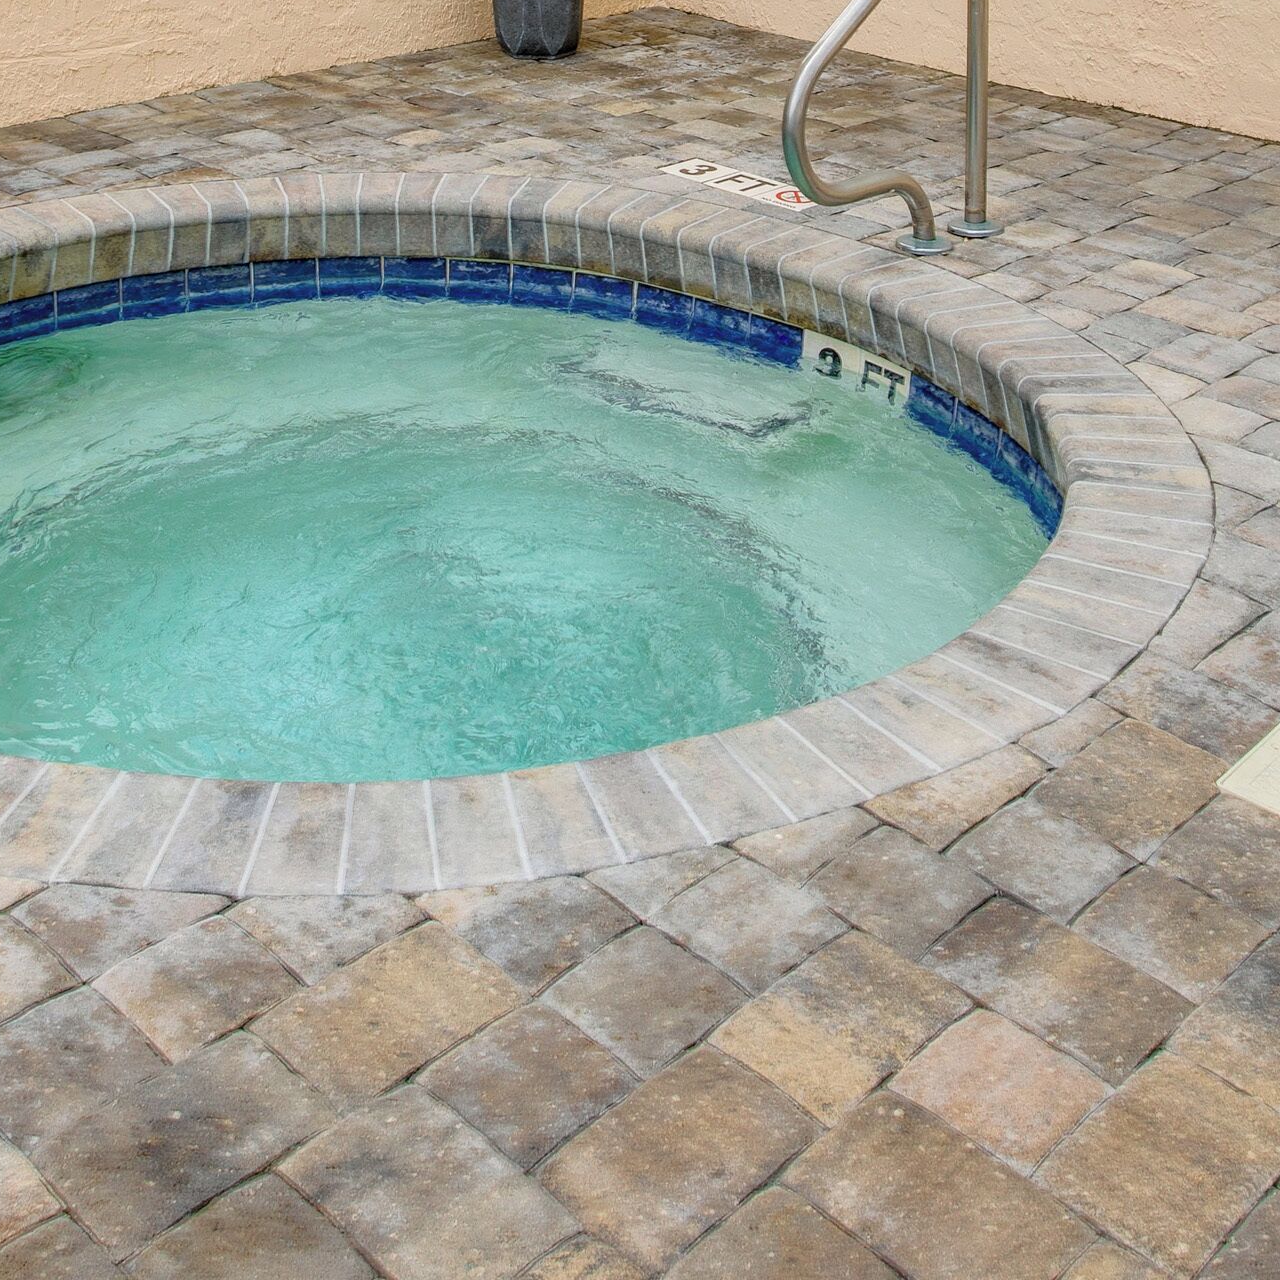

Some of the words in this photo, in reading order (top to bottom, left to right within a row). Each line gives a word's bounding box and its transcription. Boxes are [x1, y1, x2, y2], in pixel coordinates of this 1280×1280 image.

[679, 164, 718, 176] 3
[714, 173, 778, 192] FT
[861, 359, 905, 405] FT
